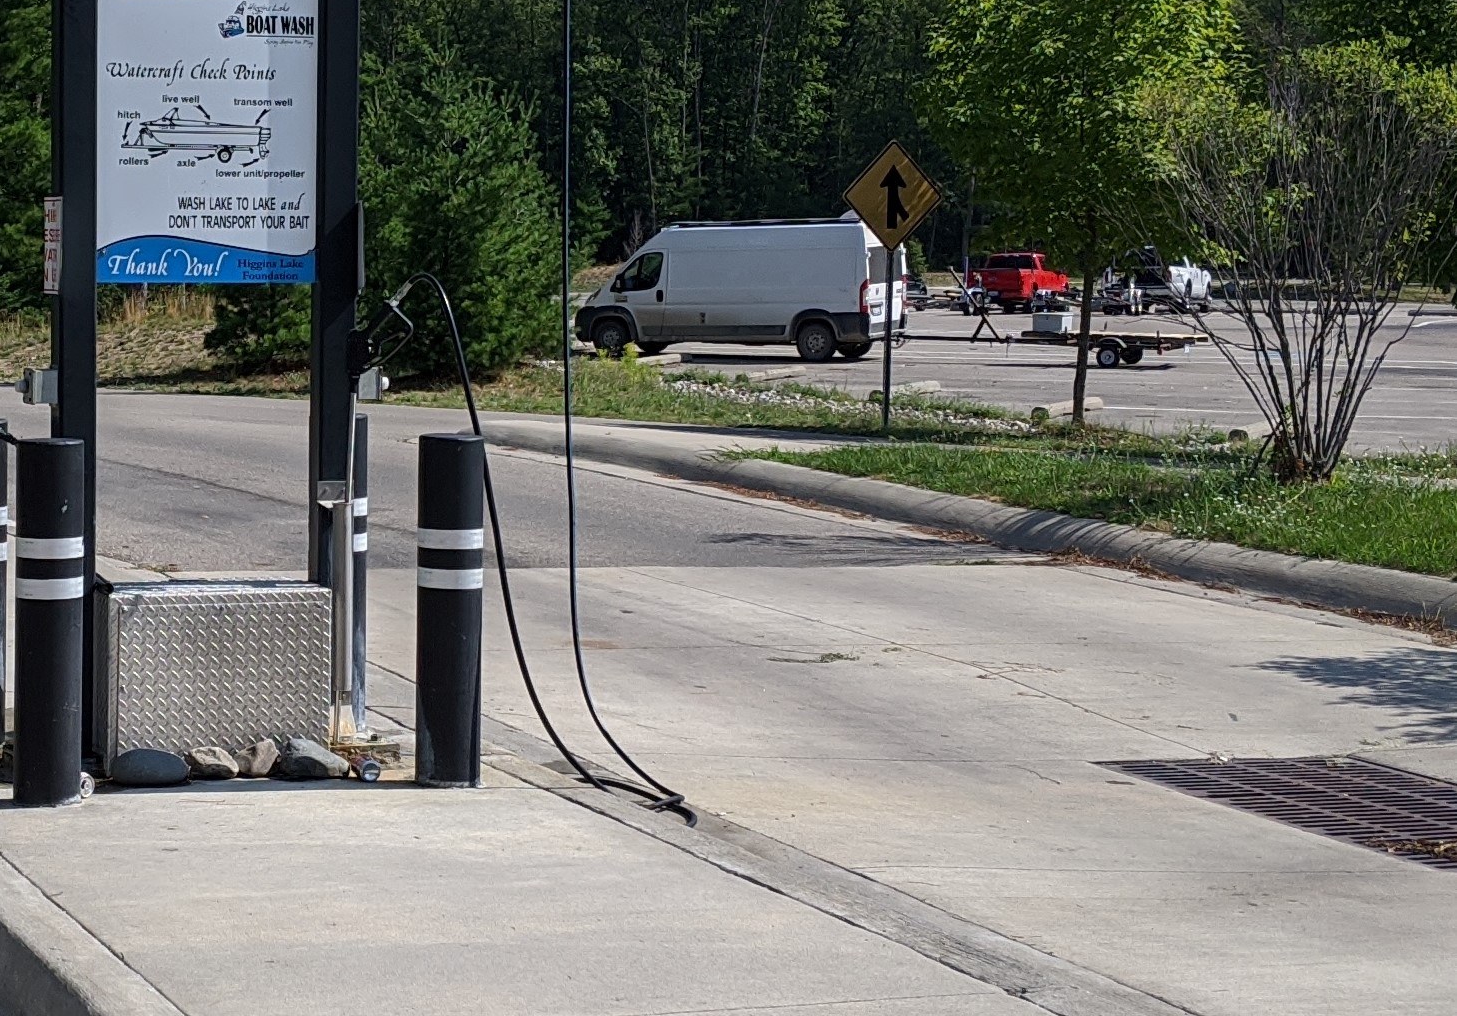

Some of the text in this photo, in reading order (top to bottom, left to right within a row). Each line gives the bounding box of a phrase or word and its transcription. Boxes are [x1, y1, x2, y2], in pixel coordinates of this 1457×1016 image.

[246, 15, 314, 36] BOAT WASH
[106, 58, 277, 86] Watercraft Check Points
[162, 95, 200, 103] live well
[234, 98, 293, 107] transom well
[117, 110, 141, 119] hitch
[119, 157, 149, 166] rollers
[177, 158, 196, 167] axle
[215, 169, 305, 179] lower unit/propeller
[178, 192, 305, 211] WASH LAKE TO LAKE and
[169, 215, 310, 229] DON'T TRANSPORT YOUR BAIT
[108, 248, 229, 277] Thank You!
[238, 259, 304, 271] Higgins Lake
[243, 271, 299, 281] Foundation
